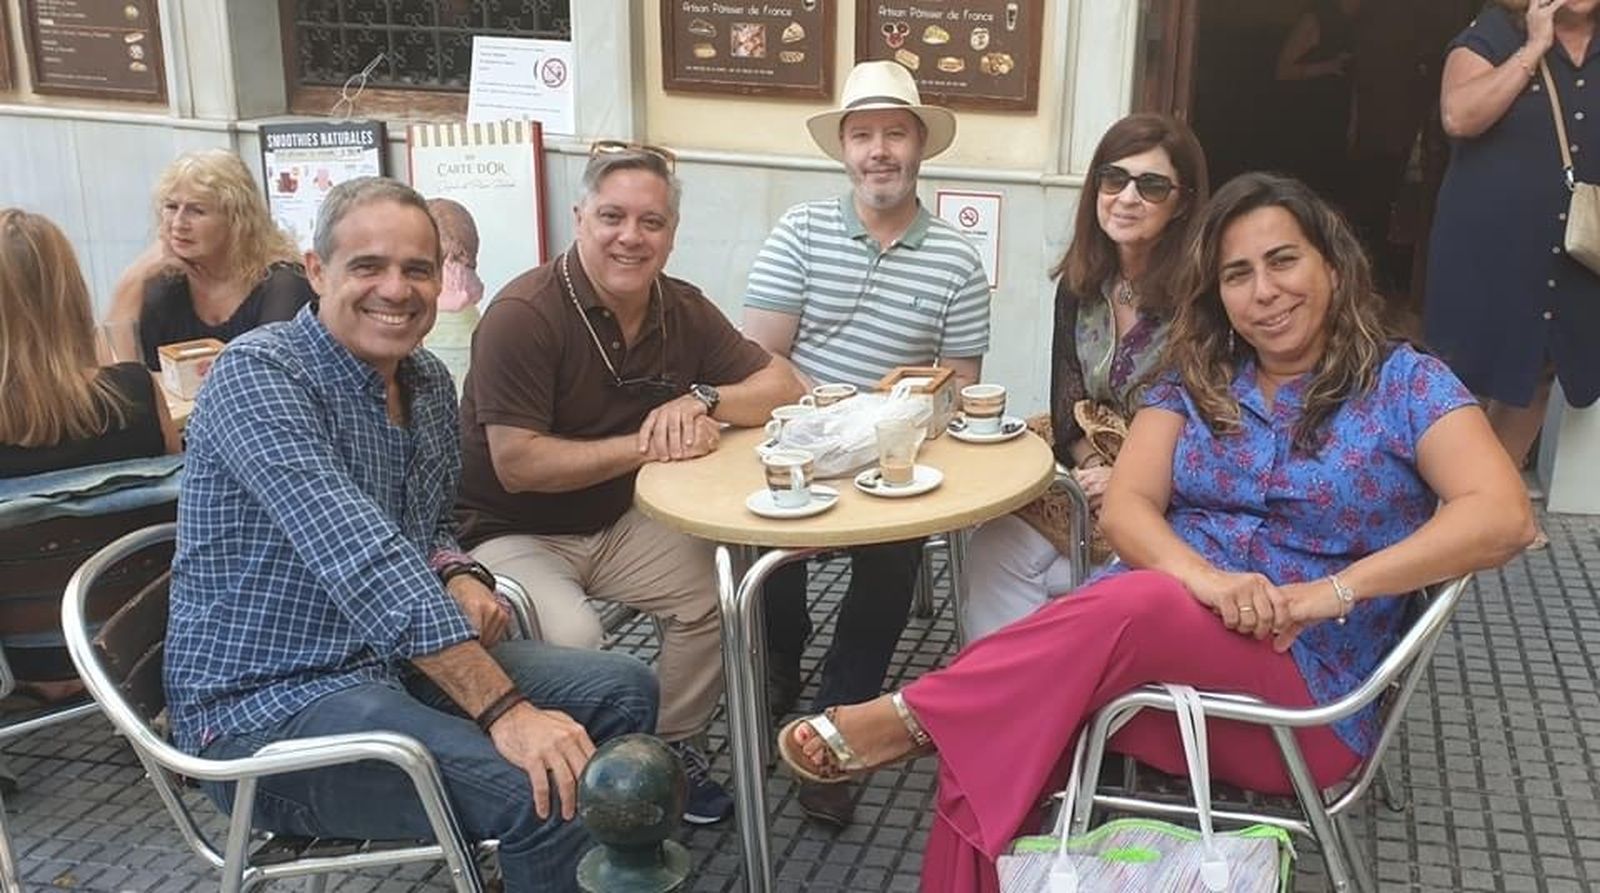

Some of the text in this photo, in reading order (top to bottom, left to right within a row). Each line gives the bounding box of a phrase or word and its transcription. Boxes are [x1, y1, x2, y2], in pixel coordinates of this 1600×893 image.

[747, 4, 760, 16] de
[946, 9, 960, 20] de
[266, 130, 374, 148] SMOOTHIES NATURALES
[437, 162, 472, 176] CARTE
